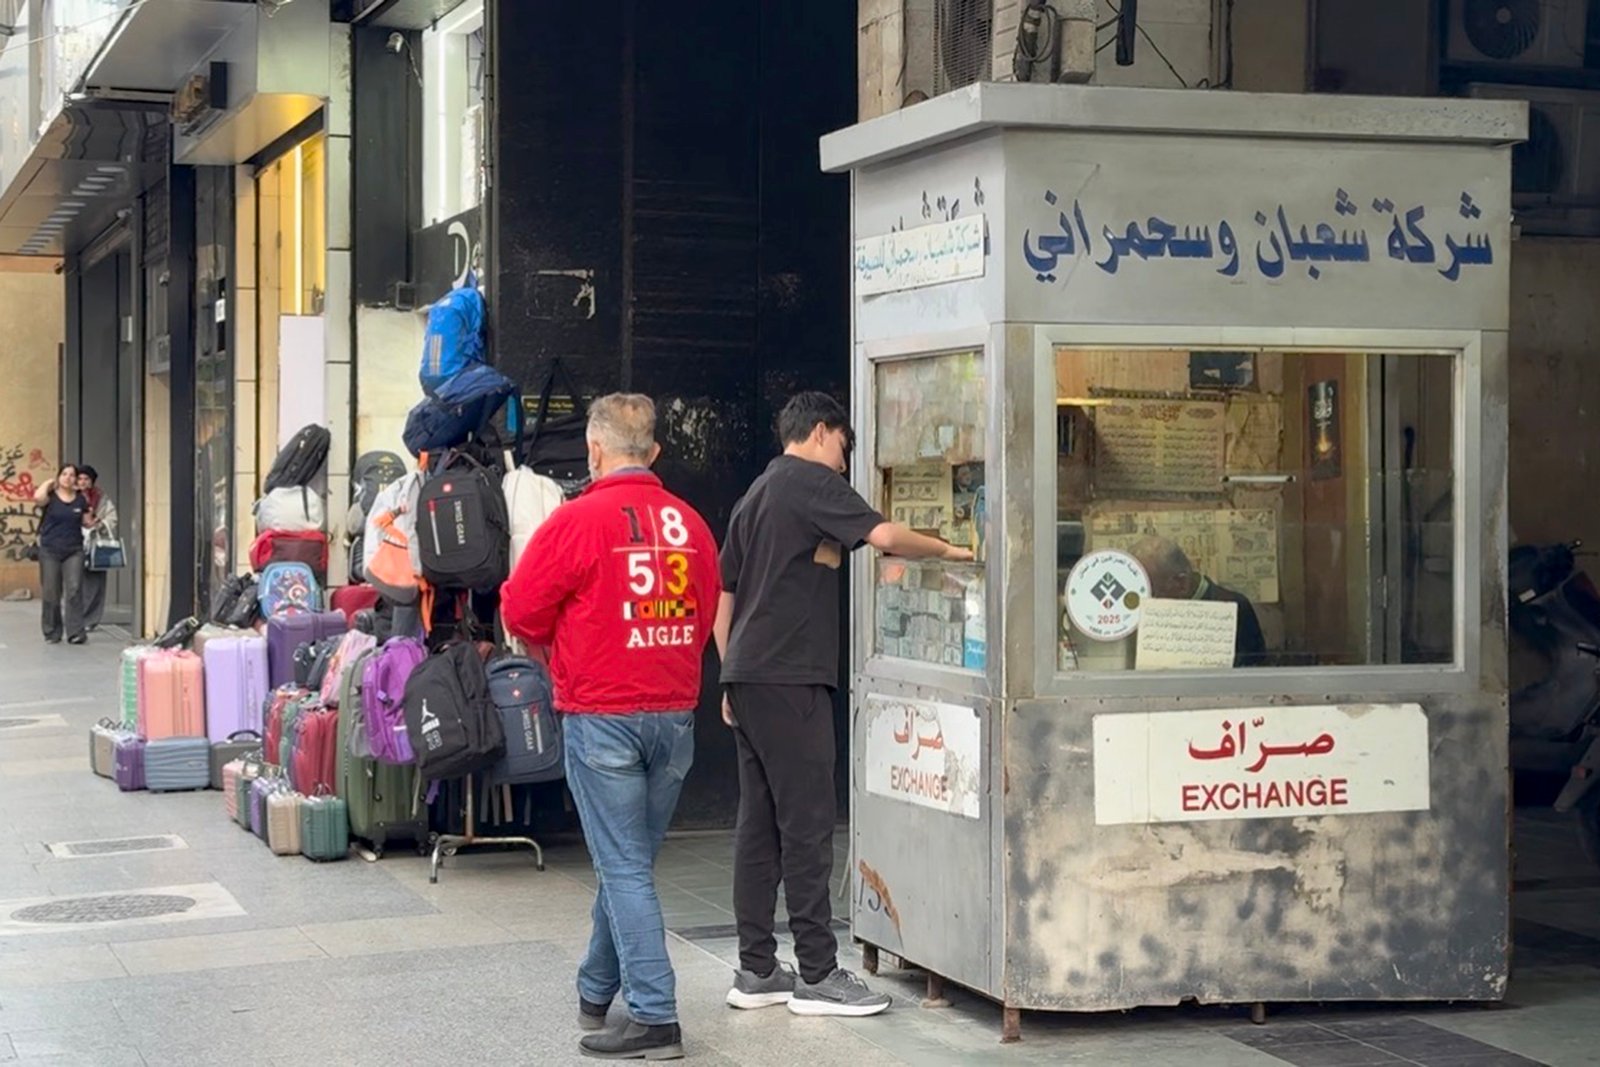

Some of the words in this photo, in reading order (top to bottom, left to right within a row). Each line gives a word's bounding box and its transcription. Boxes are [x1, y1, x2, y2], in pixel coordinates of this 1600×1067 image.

[1022, 189, 1241, 284] وسحمراني
[1254, 187, 1371, 280] شعبان
[1371, 190, 1494, 282] شركة
[626, 625, 695, 649] AIGLE
[1097, 614, 1121, 624] 2025
[891, 765, 949, 802] EXCHANGE
[1181, 779, 1348, 812] EXCHANGE
